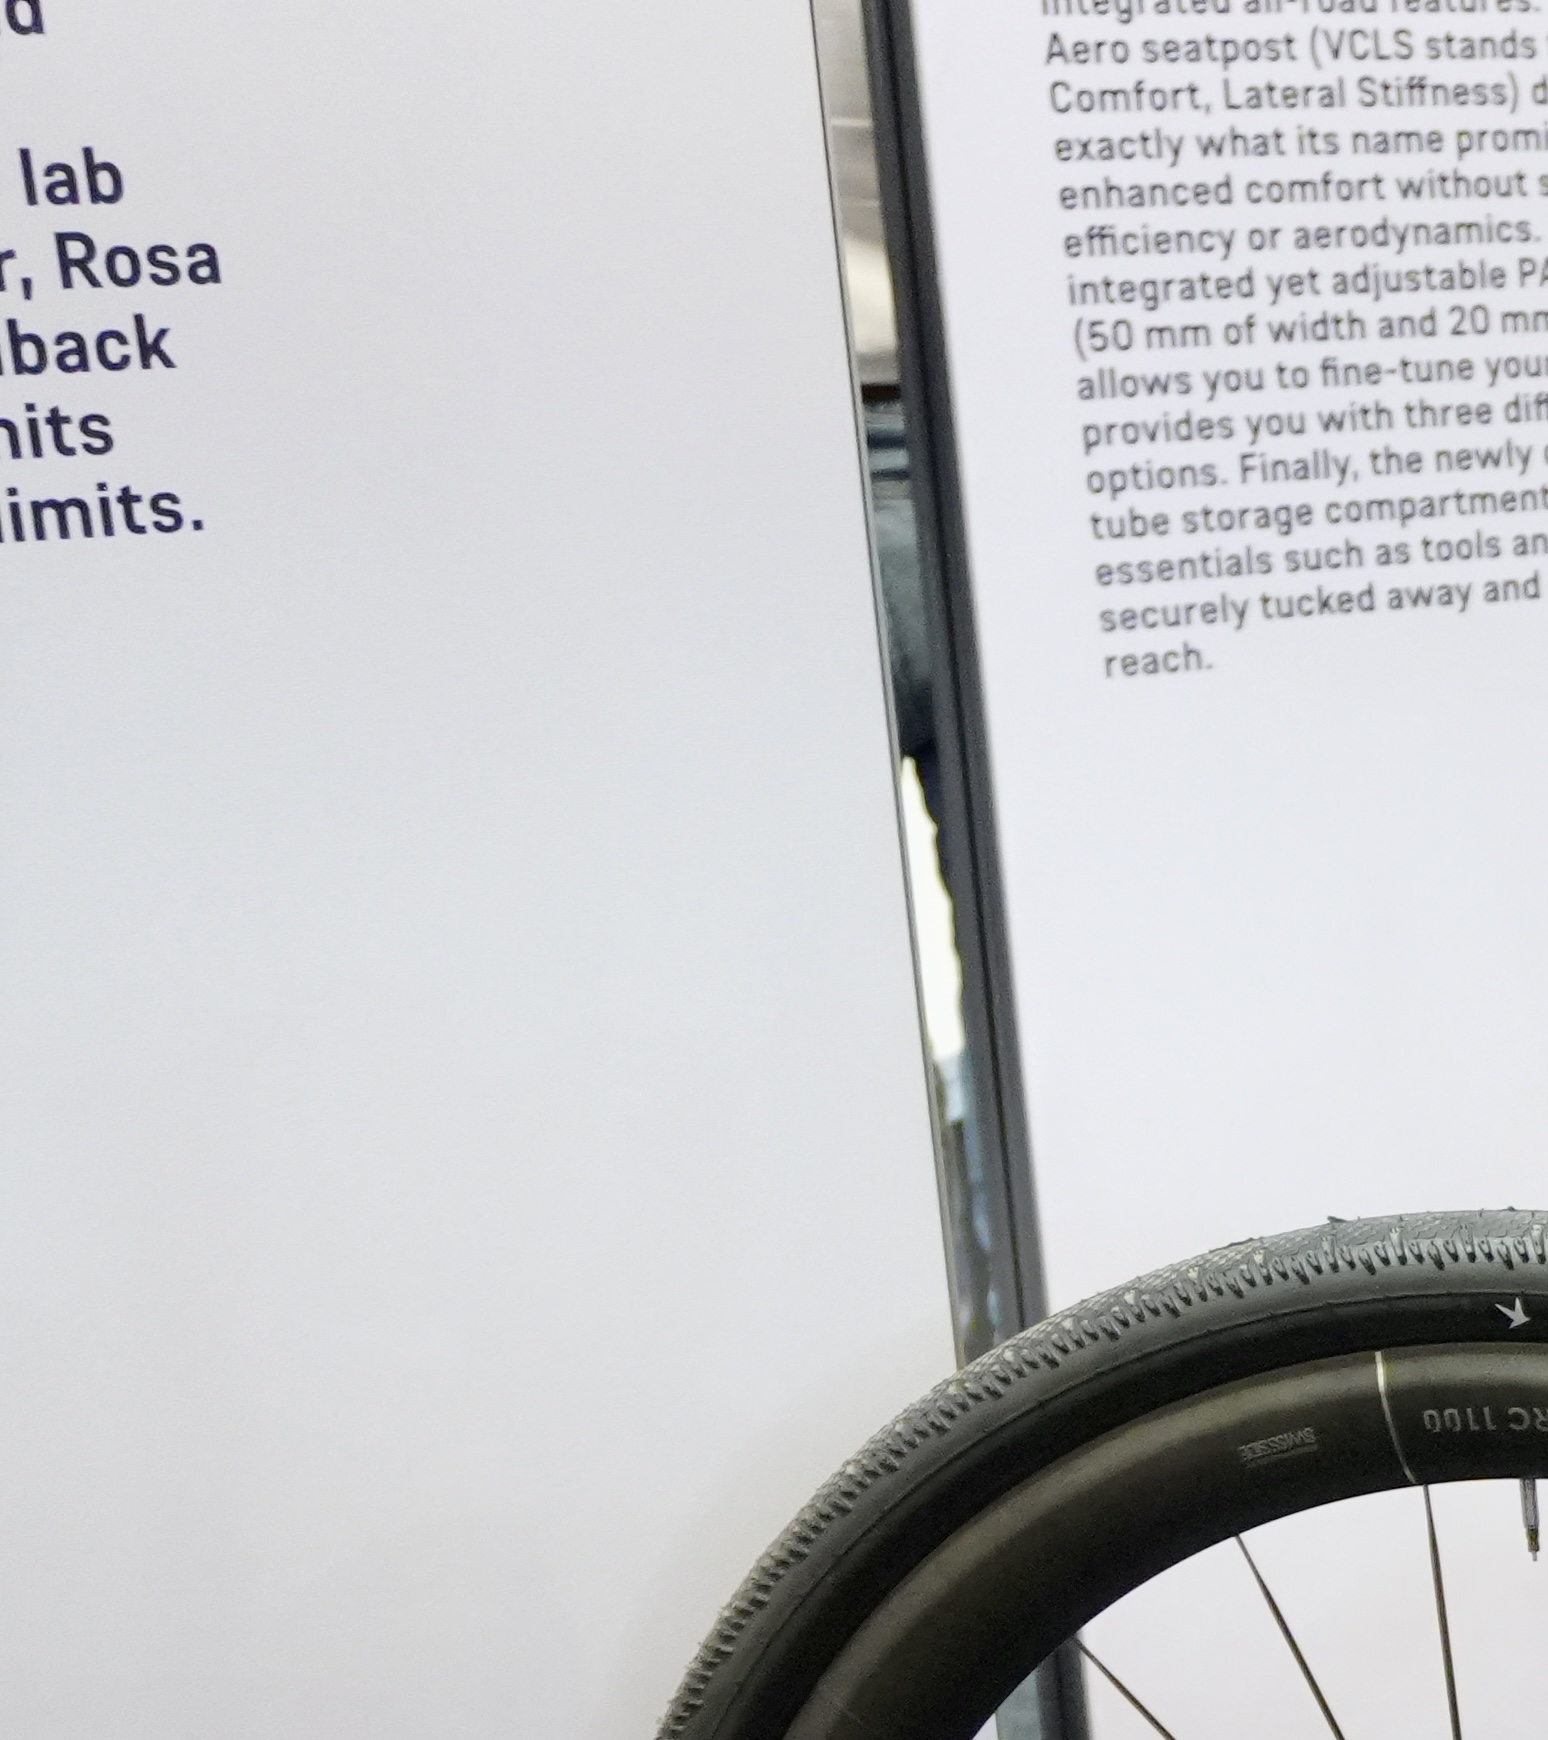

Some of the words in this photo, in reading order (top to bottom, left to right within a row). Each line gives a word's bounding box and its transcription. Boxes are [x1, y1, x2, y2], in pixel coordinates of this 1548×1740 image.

[1044, 31, 1131, 66] Aero
[1141, 33, 1298, 72] seatpost
[1309, 25, 1415, 70] (VCLS
[1424, 29, 1538, 61] stands
[1049, 79, 1211, 115] Comfort,
[1222, 76, 1346, 111] Lateral
[1356, 72, 1520, 114] Stiffness)
[1053, 127, 1185, 168] exactly
[1194, 126, 1286, 158] what
[1296, 125, 1341, 156] its
[1351, 129, 1445, 155] name
[18, 146, 124, 206] lab
[1058, 173, 1234, 211] enhanced
[1245, 170, 1387, 205] comfort
[1395, 168, 1529, 200] without
[54, 231, 222, 290] Rosa
[1063, 224, 1236, 262] efficiency
[1247, 227, 1283, 252] or
[1293, 216, 1541, 256] aerodynamics.
[1067, 266, 1256, 312] integrated
[1265, 267, 1321, 307] yet
[1332, 259, 1507, 303] adjustable
[0, 313, 177, 376] back
[1073, 317, 1134, 362] (50
[1144, 323, 1212, 350] mm
[1223, 313, 1257, 347] of
[1266, 309, 1367, 344] width
[1377, 306, 1438, 340] and
[1448, 303, 1491, 337] 20
[1077, 367, 1194, 401] allows
[1202, 367, 1266, 403] you
[1274, 362, 1310, 390] to
[1318, 356, 1475, 388] fine-tune
[1081, 410, 1235, 457] provides
[1244, 412, 1307, 446] you
[1316, 400, 1394, 433] with
[1403, 398, 1494, 429] three
[1085, 460, 1228, 501] options.
[1239, 448, 1359, 487] Finally,
[1368, 445, 1424, 477] the
[1434, 438, 1533, 476] newly
[0, 482, 204, 543] imits.
[1089, 507, 1171, 541] tube
[1180, 503, 1314, 537] storage
[1094, 545, 1274, 588] essentials
[1284, 538, 1365, 573] such
[1375, 542, 1412, 567] as
[1420, 530, 1503, 563] tools
[1098, 593, 1249, 634] securely
[1258, 581, 1377, 621] tucked
[1386, 583, 1472, 614] away
[1483, 570, 1542, 604] and
[1104, 641, 1214, 679] reach.
[1422, 1406, 1497, 1433] 1100
